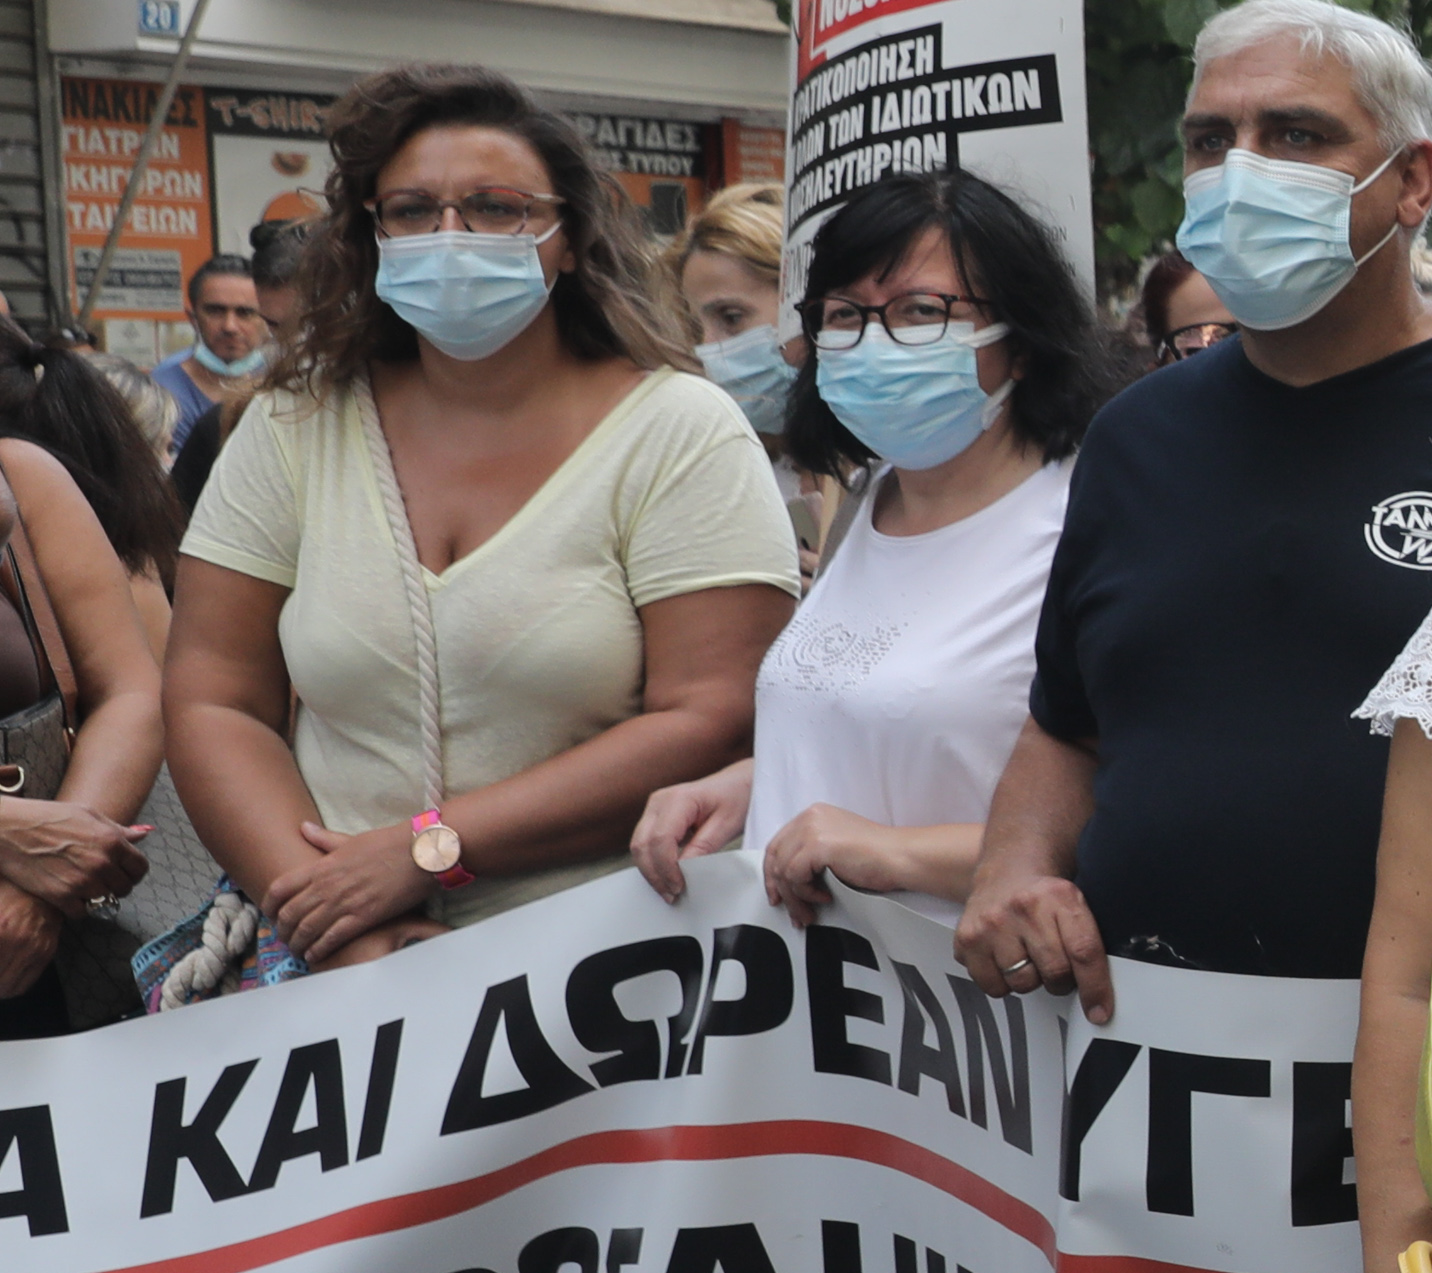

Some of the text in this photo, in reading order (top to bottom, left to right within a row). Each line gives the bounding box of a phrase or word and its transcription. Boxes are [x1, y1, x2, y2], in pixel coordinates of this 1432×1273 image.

[829, 103, 866, 150] ΤΩΝ
[870, 68, 1042, 134] ΙΔΙΩΤΙΚΩΝ
[141, 1020, 398, 1218] ΚΑΙ
[440, 923, 1033, 1156] ΔΩΡΕΑΝ
